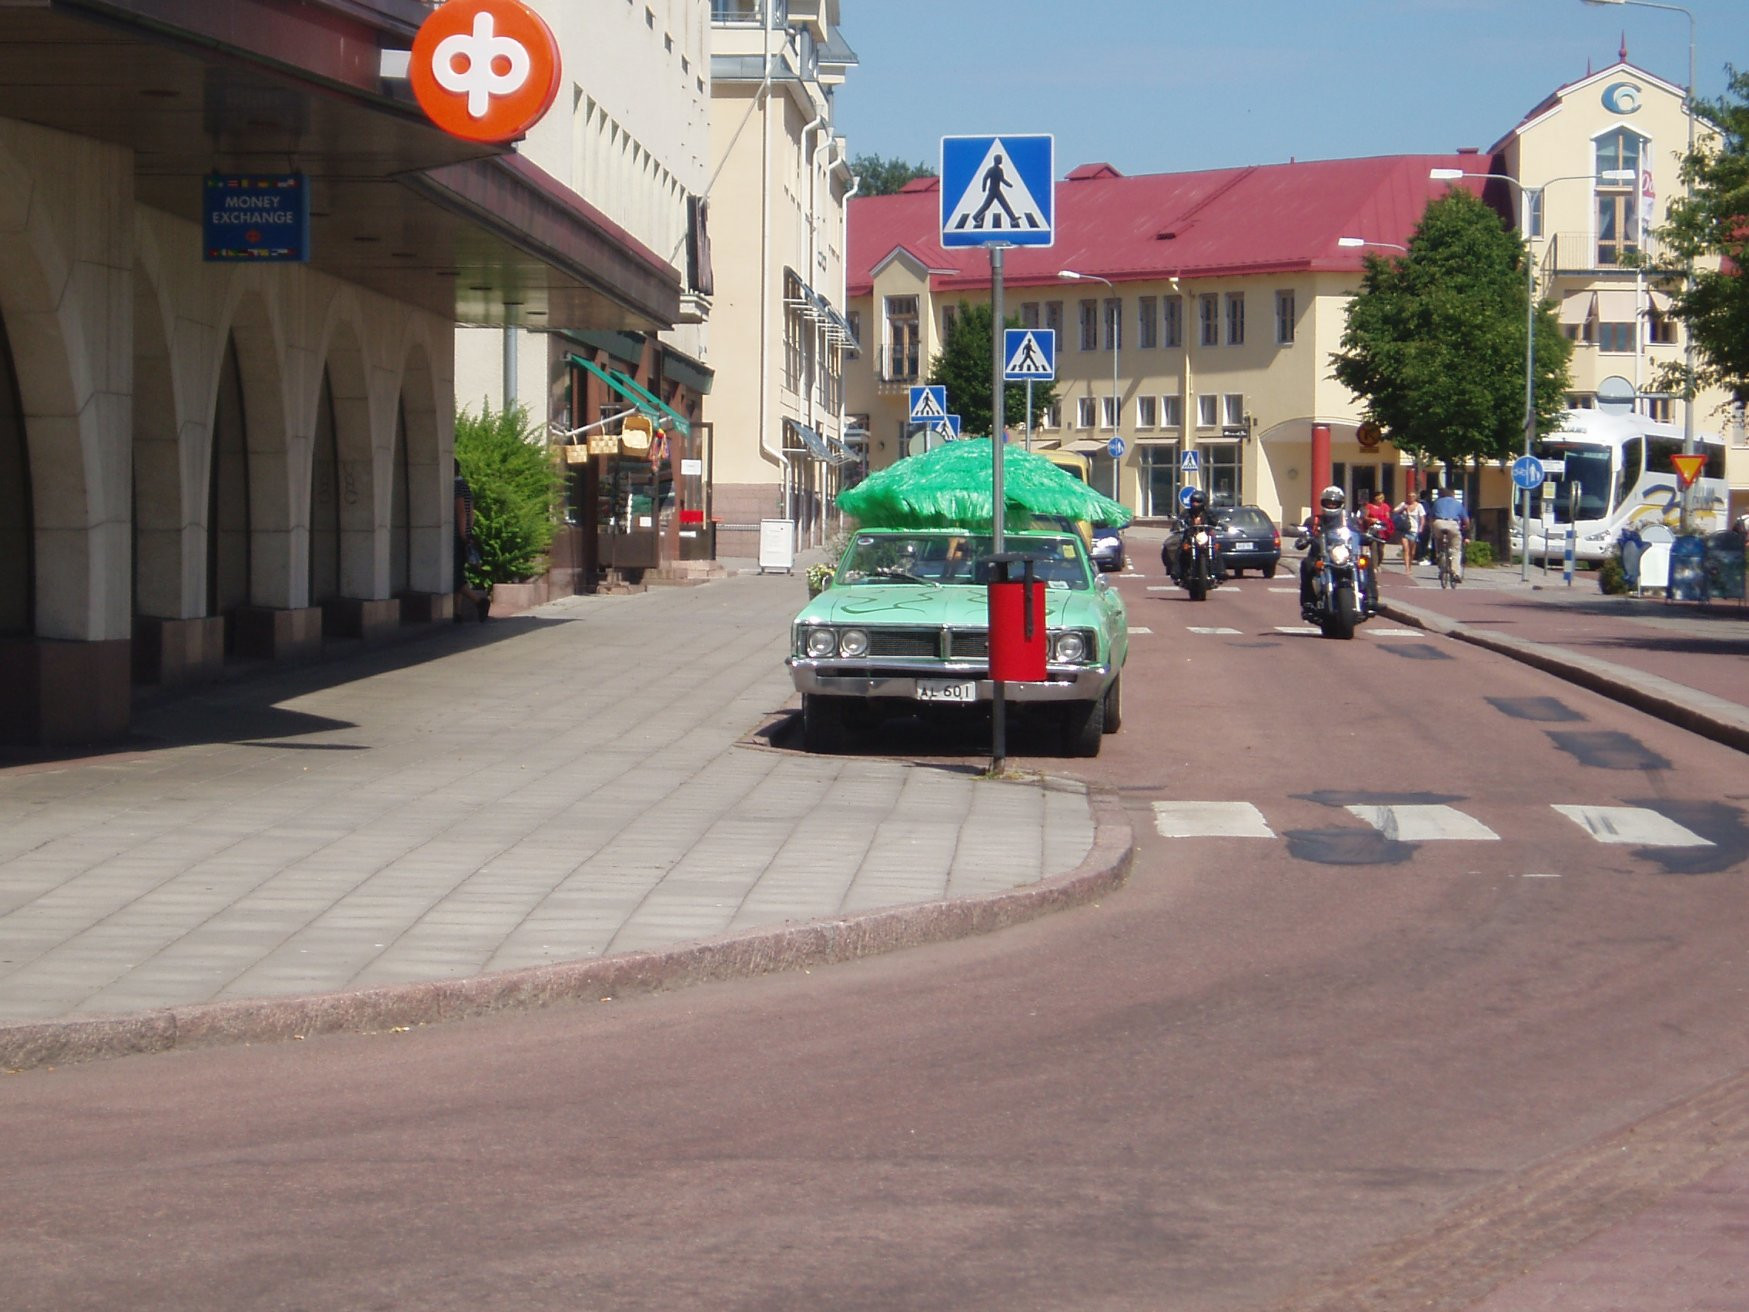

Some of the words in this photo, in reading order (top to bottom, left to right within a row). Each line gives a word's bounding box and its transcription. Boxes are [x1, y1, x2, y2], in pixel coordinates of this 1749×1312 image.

[225, 195, 281, 208] MONEY
[212, 211, 294, 224] EXCHANGE
[920, 687, 938, 697] AL
[943, 684, 969, 698] 601
